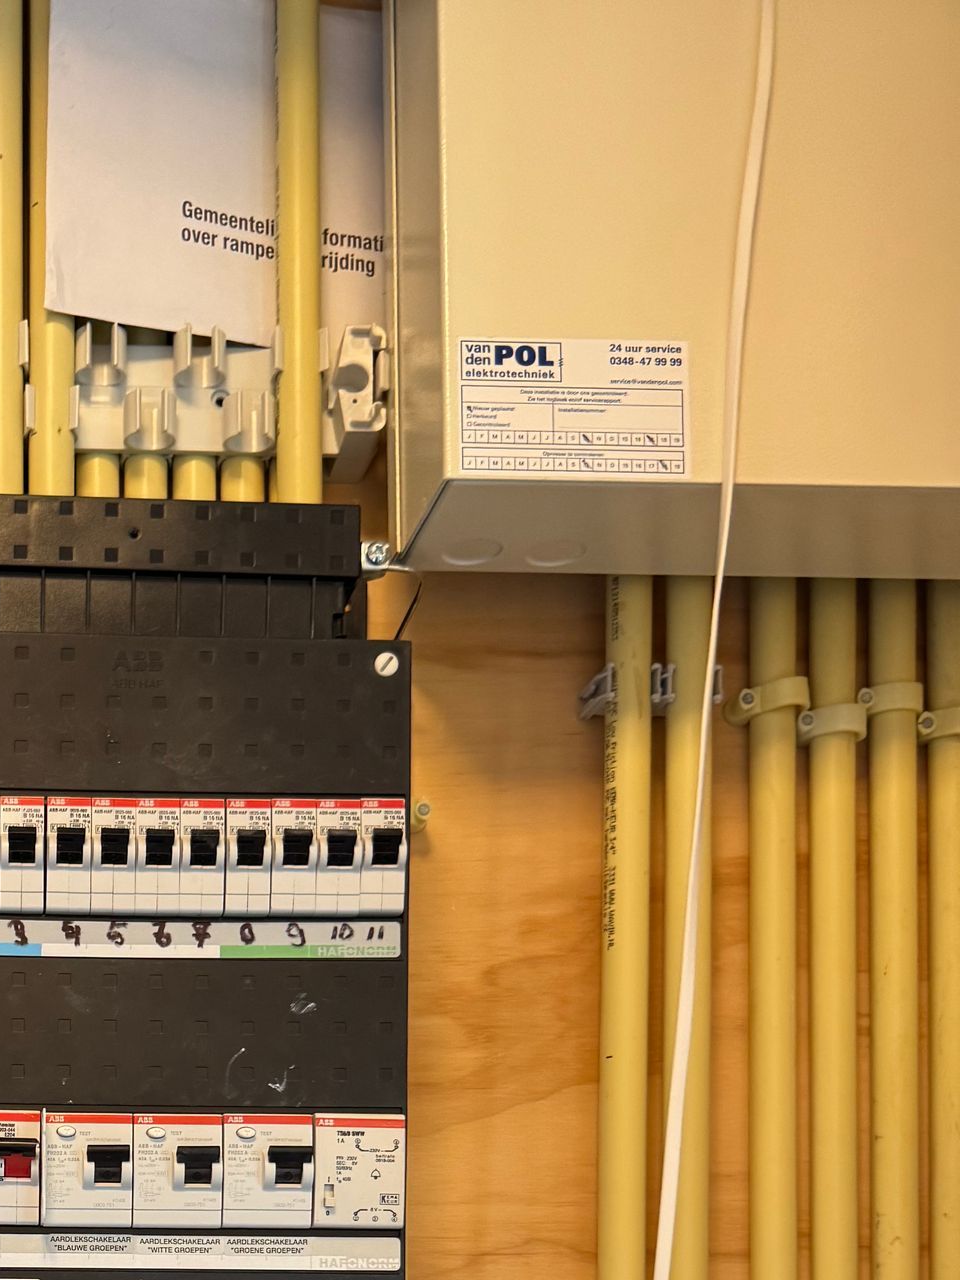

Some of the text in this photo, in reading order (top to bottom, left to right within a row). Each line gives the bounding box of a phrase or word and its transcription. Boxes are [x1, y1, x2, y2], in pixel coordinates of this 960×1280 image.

[181, 200, 384, 252] Gemeenteli formati
[181, 227, 375, 278] over rampe rijding
[609, 344, 682, 354] 24 uur service
[465, 343, 491, 366] van den
[494, 345, 554, 367] POL
[653, 358, 667, 366] 99
[669, 358, 682, 367] 99
[465, 369, 555, 379] elektrotechniek
[331, 922, 355, 940] 10
[367, 924, 385, 941] 11
[49, 1115, 64, 1123] ABB
[50, 1236, 132, 1244] AARDLEKSCHAKELAAR
[226, 1238, 308, 1246] AARDLEKSCHAKELAAR
[54, 1244, 128, 1252] "BLAUWE GROEPEN"
[147, 1246, 213, 1254] "WITTE GROEPEN"
[230, 1246, 304, 1255] "GROENE GROEPEN"
[318, 1257, 399, 1269] HAFONORM
